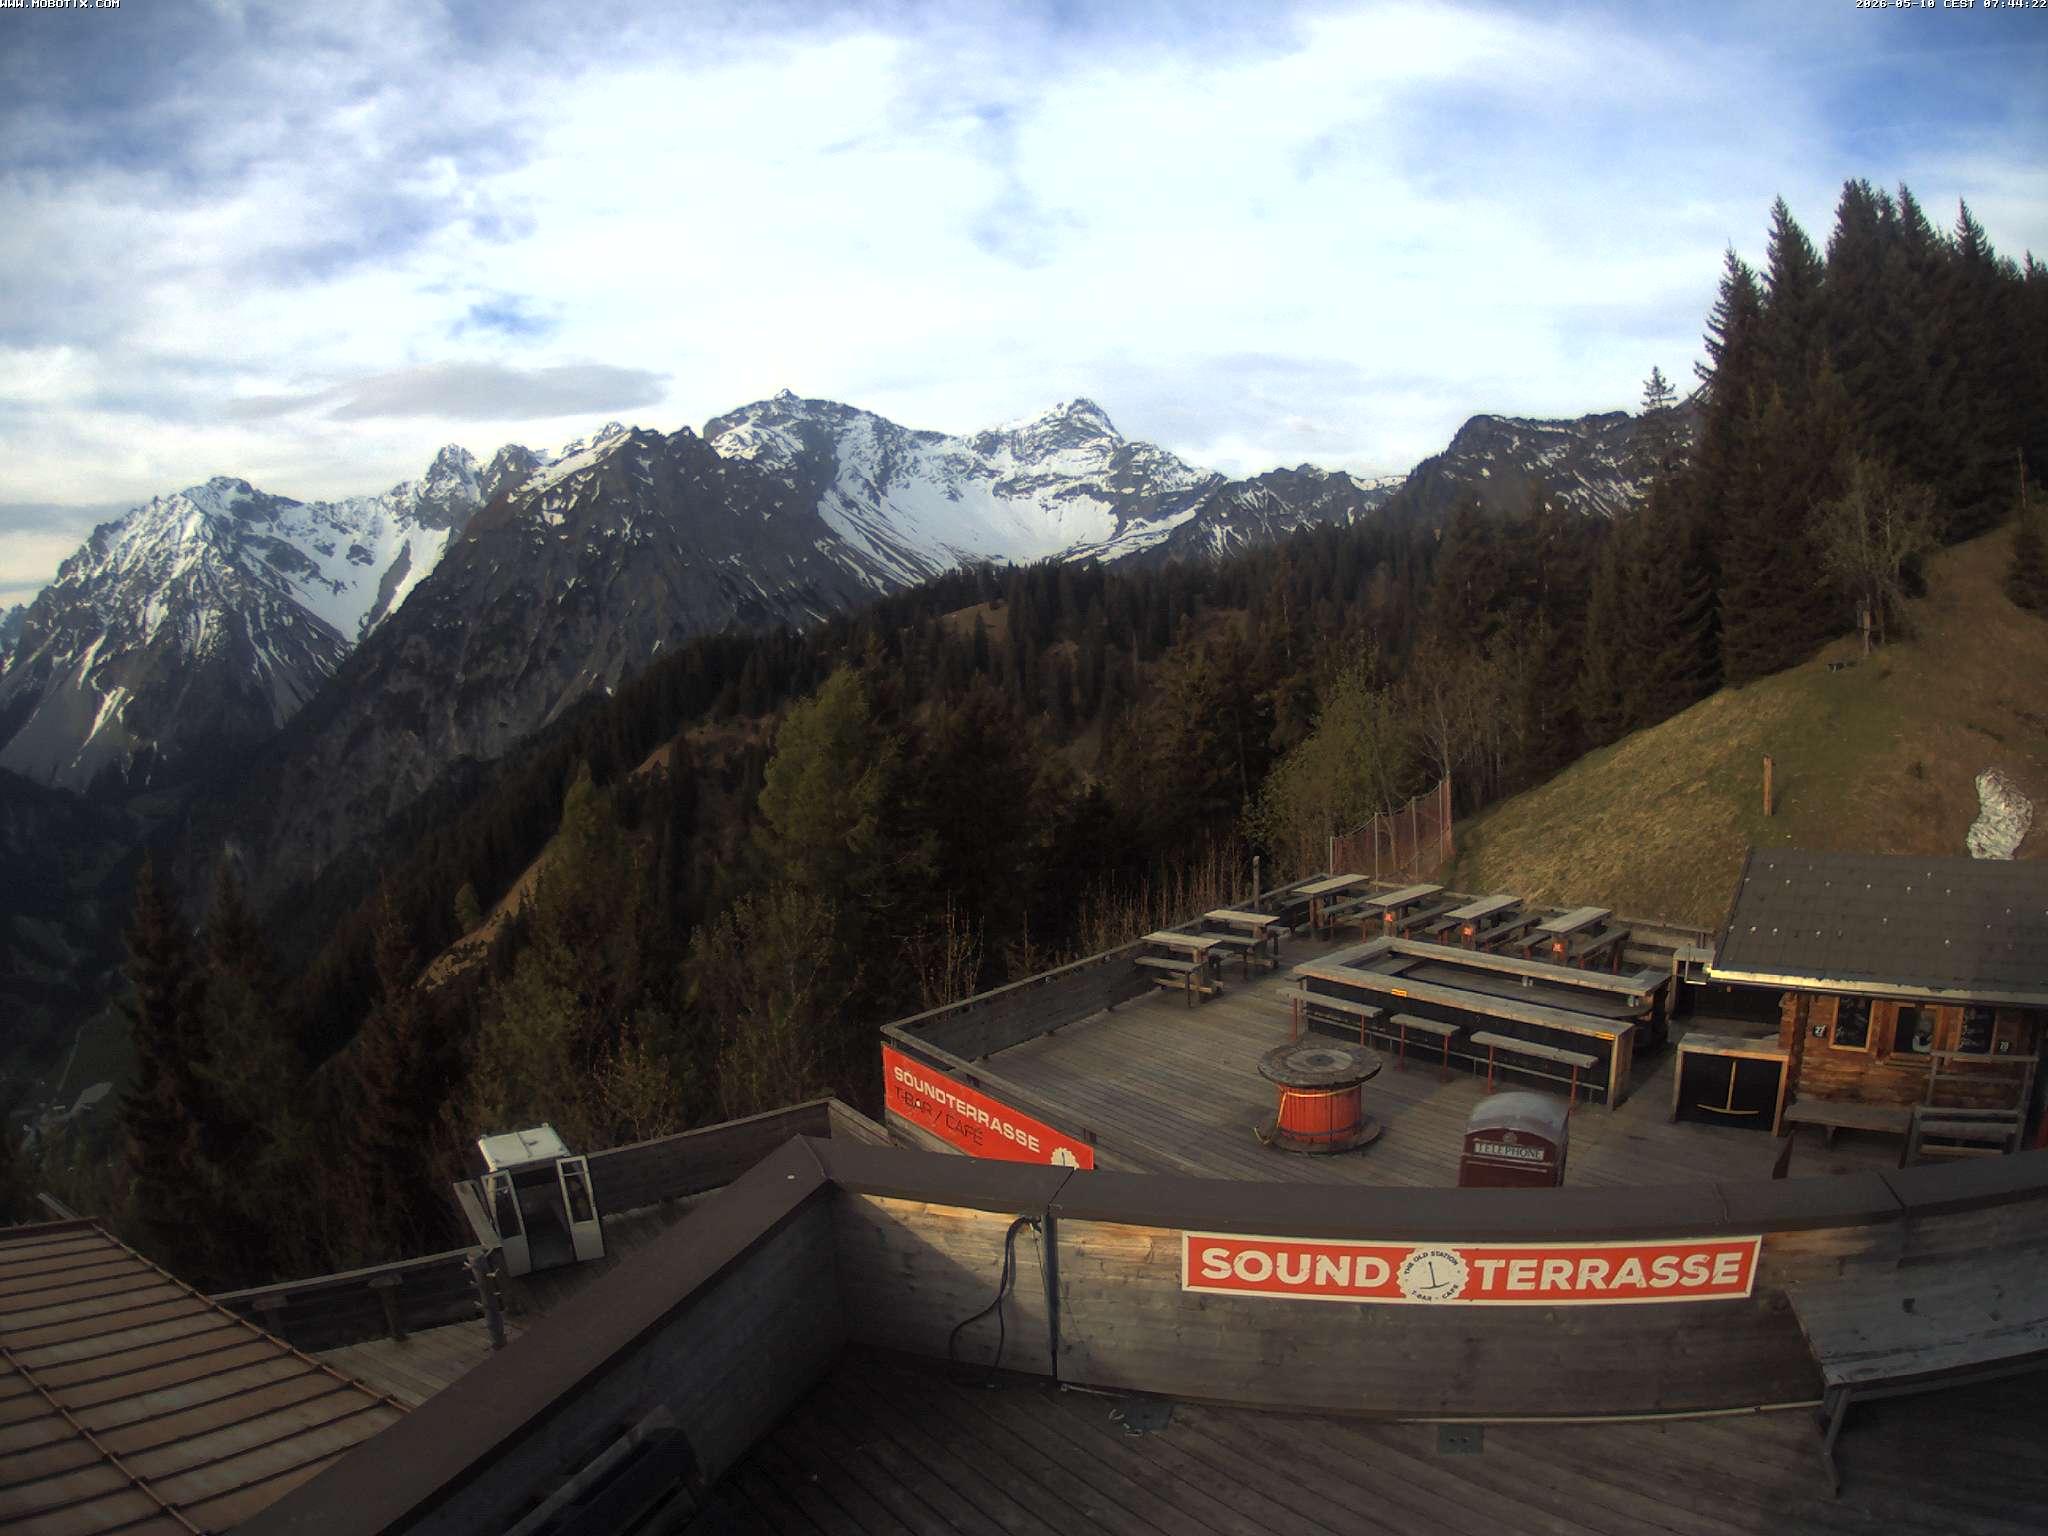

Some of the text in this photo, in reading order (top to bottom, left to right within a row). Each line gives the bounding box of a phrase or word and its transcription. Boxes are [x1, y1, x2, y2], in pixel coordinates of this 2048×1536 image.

[894, 1066, 1041, 1153] SOUNDTERRASSE
[1473, 1143, 1545, 1160] TELEPHONE
[1201, 1247, 1743, 1291] SOUND TERRASSE
[1404, 1250, 1459, 1274] THE OLD STATION
